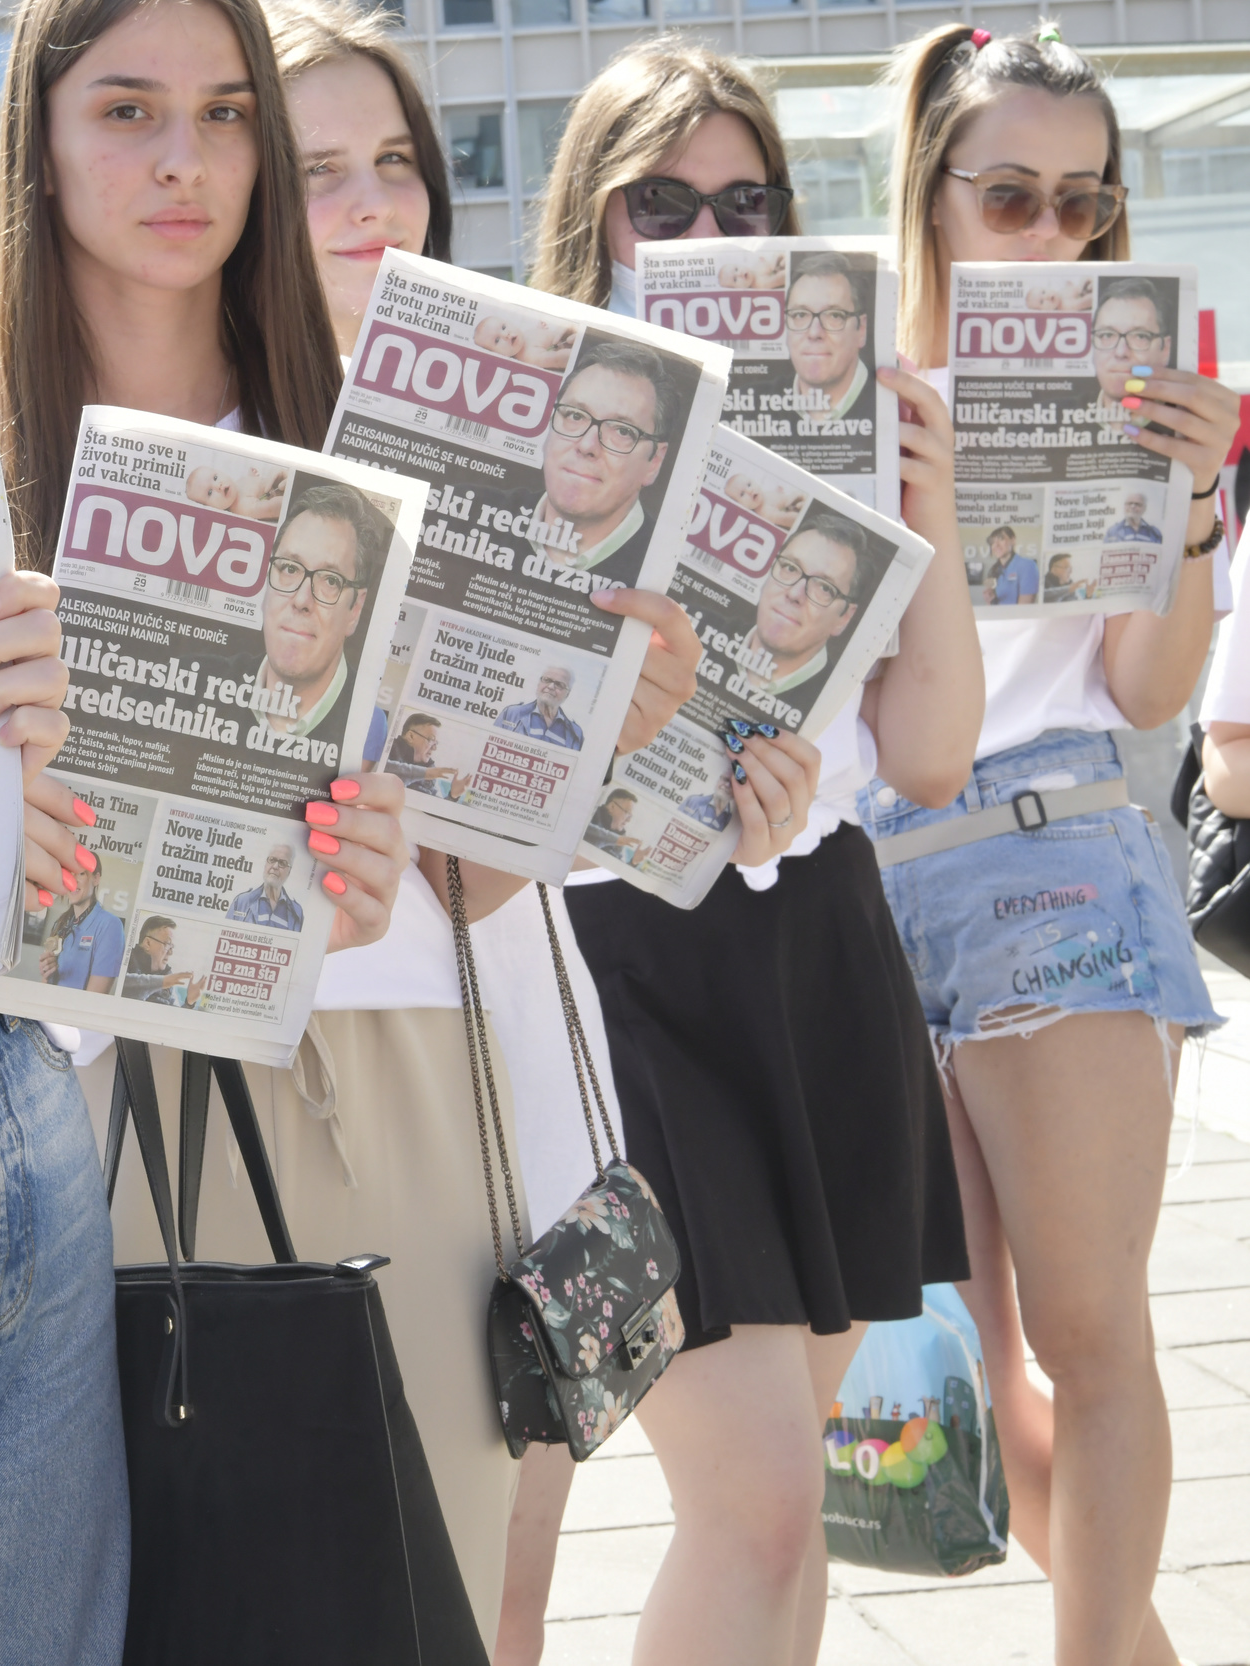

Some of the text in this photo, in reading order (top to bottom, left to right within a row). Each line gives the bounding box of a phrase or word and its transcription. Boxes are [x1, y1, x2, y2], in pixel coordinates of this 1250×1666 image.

[650, 296, 781, 336] nova
[959, 317, 1088, 354] nova
[362, 333, 550, 430] nova
[956, 403, 1057, 425] Uličarski
[503, 440, 535, 456] nova.rs
[955, 426, 1092, 451] predsednika
[71, 495, 266, 588] nova
[477, 505, 582, 554] rečnik
[224, 602, 255, 617] nova.rs
[434, 628, 515, 665] Nove ljude
[702, 625, 778, 681] rečnik
[423, 668, 504, 702] onima koji
[429, 648, 524, 688] tražim među
[204, 672, 302, 720] rečnik
[417, 682, 499, 721] brane reke
[728, 668, 803, 728] države
[63, 684, 338, 768] redsednika države
[994, 889, 1087, 920] EVERYTHING
[1012, 940, 1133, 995] CHANGING
